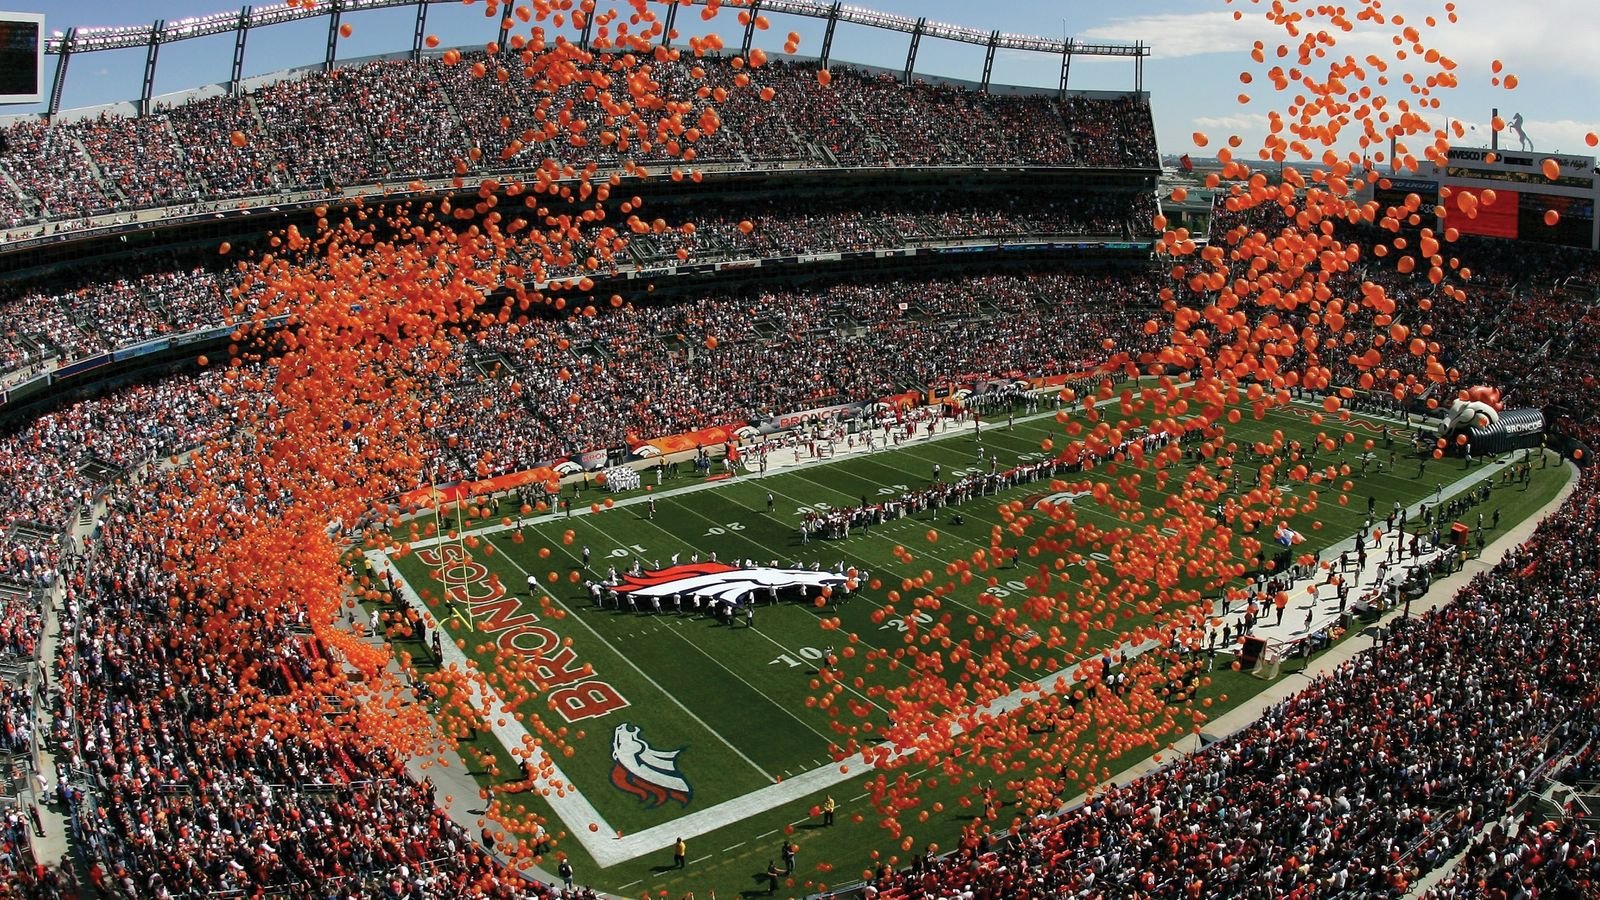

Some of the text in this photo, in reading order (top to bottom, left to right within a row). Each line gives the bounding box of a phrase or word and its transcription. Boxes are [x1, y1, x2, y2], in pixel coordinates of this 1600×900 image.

[1505, 420, 1543, 433] BRONCOS
[878, 484, 909, 495] 40
[708, 521, 746, 536] 20
[611, 543, 648, 558] 10
[985, 580, 1028, 598] 30
[887, 612, 934, 632] 20
[415, 544, 632, 724] BRONCOS
[776, 647, 823, 667] 10
